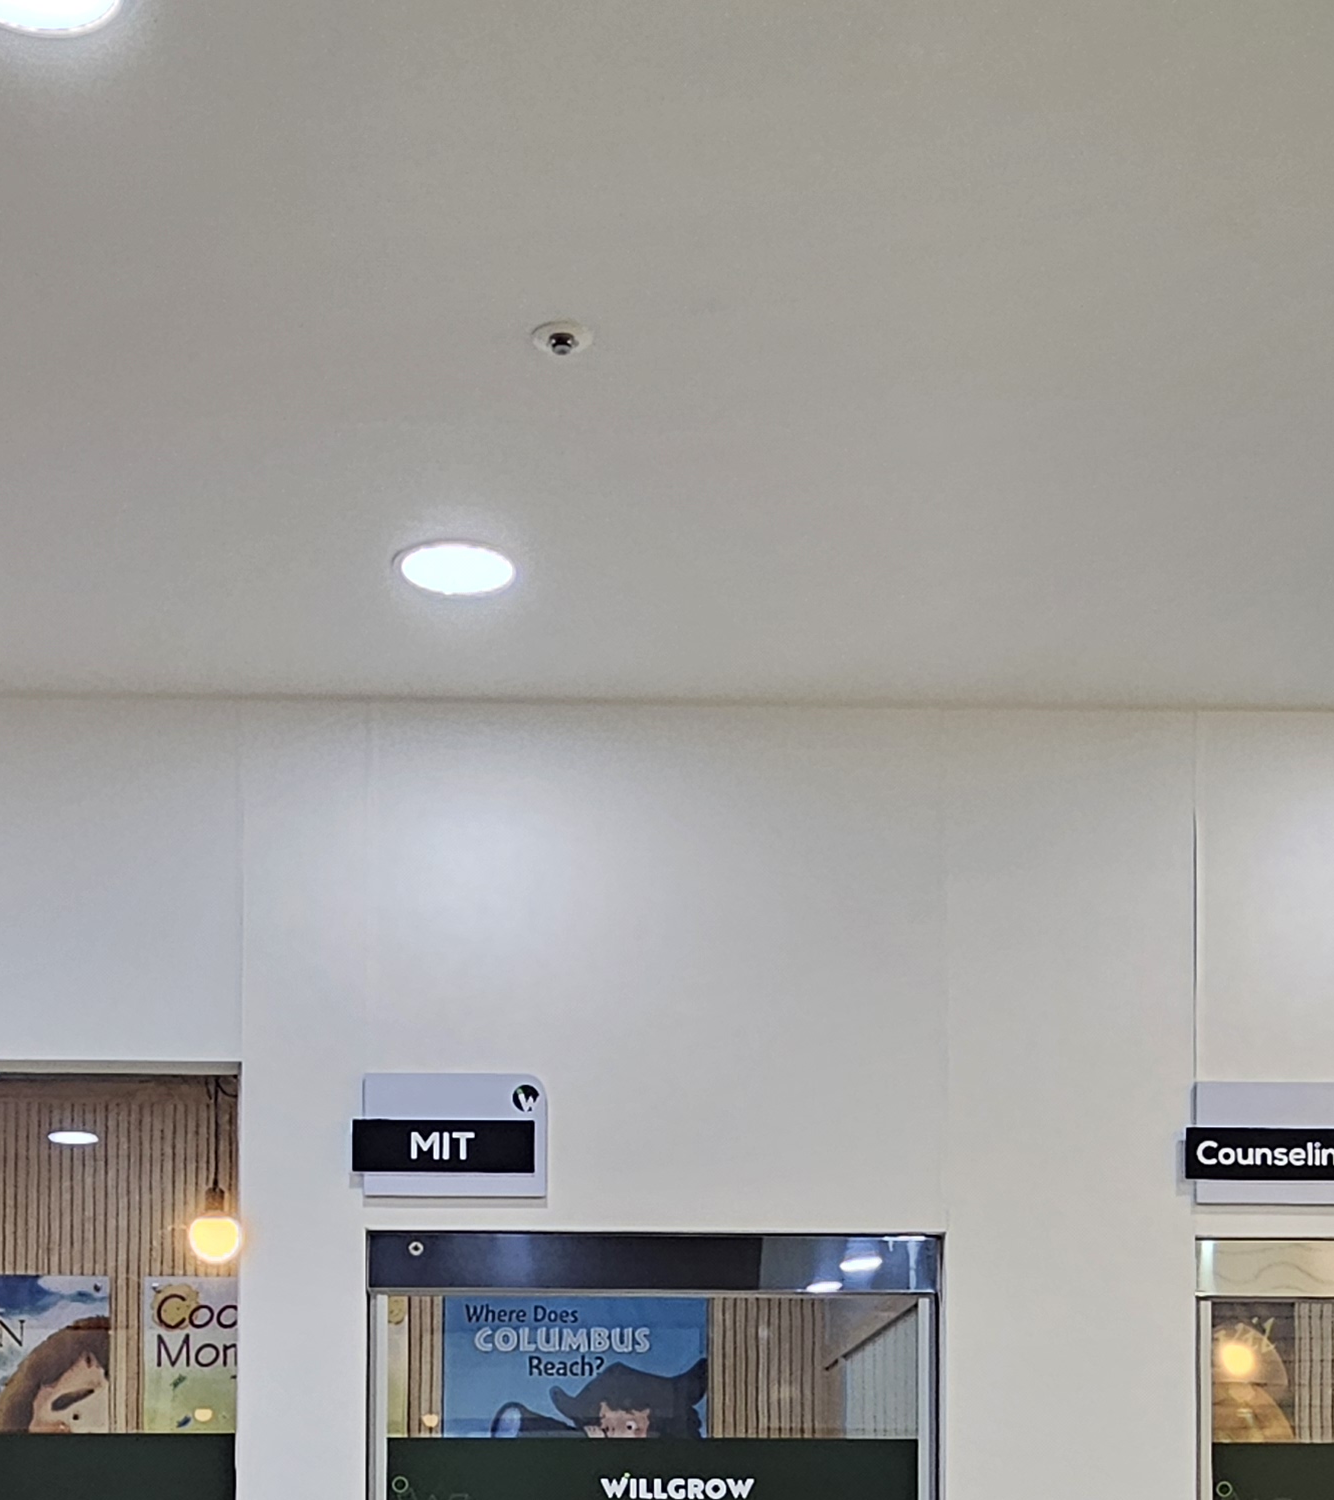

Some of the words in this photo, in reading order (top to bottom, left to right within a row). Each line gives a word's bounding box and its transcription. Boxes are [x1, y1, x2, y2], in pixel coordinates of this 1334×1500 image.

[410, 1131, 476, 1161] MIT
[465, 1303, 527, 1323] Where
[533, 1304, 579, 1323] Does
[474, 1326, 651, 1353] COLUMBUS
[528, 1355, 605, 1377] Reach?
[600, 1472, 755, 1500] WILLGROW
